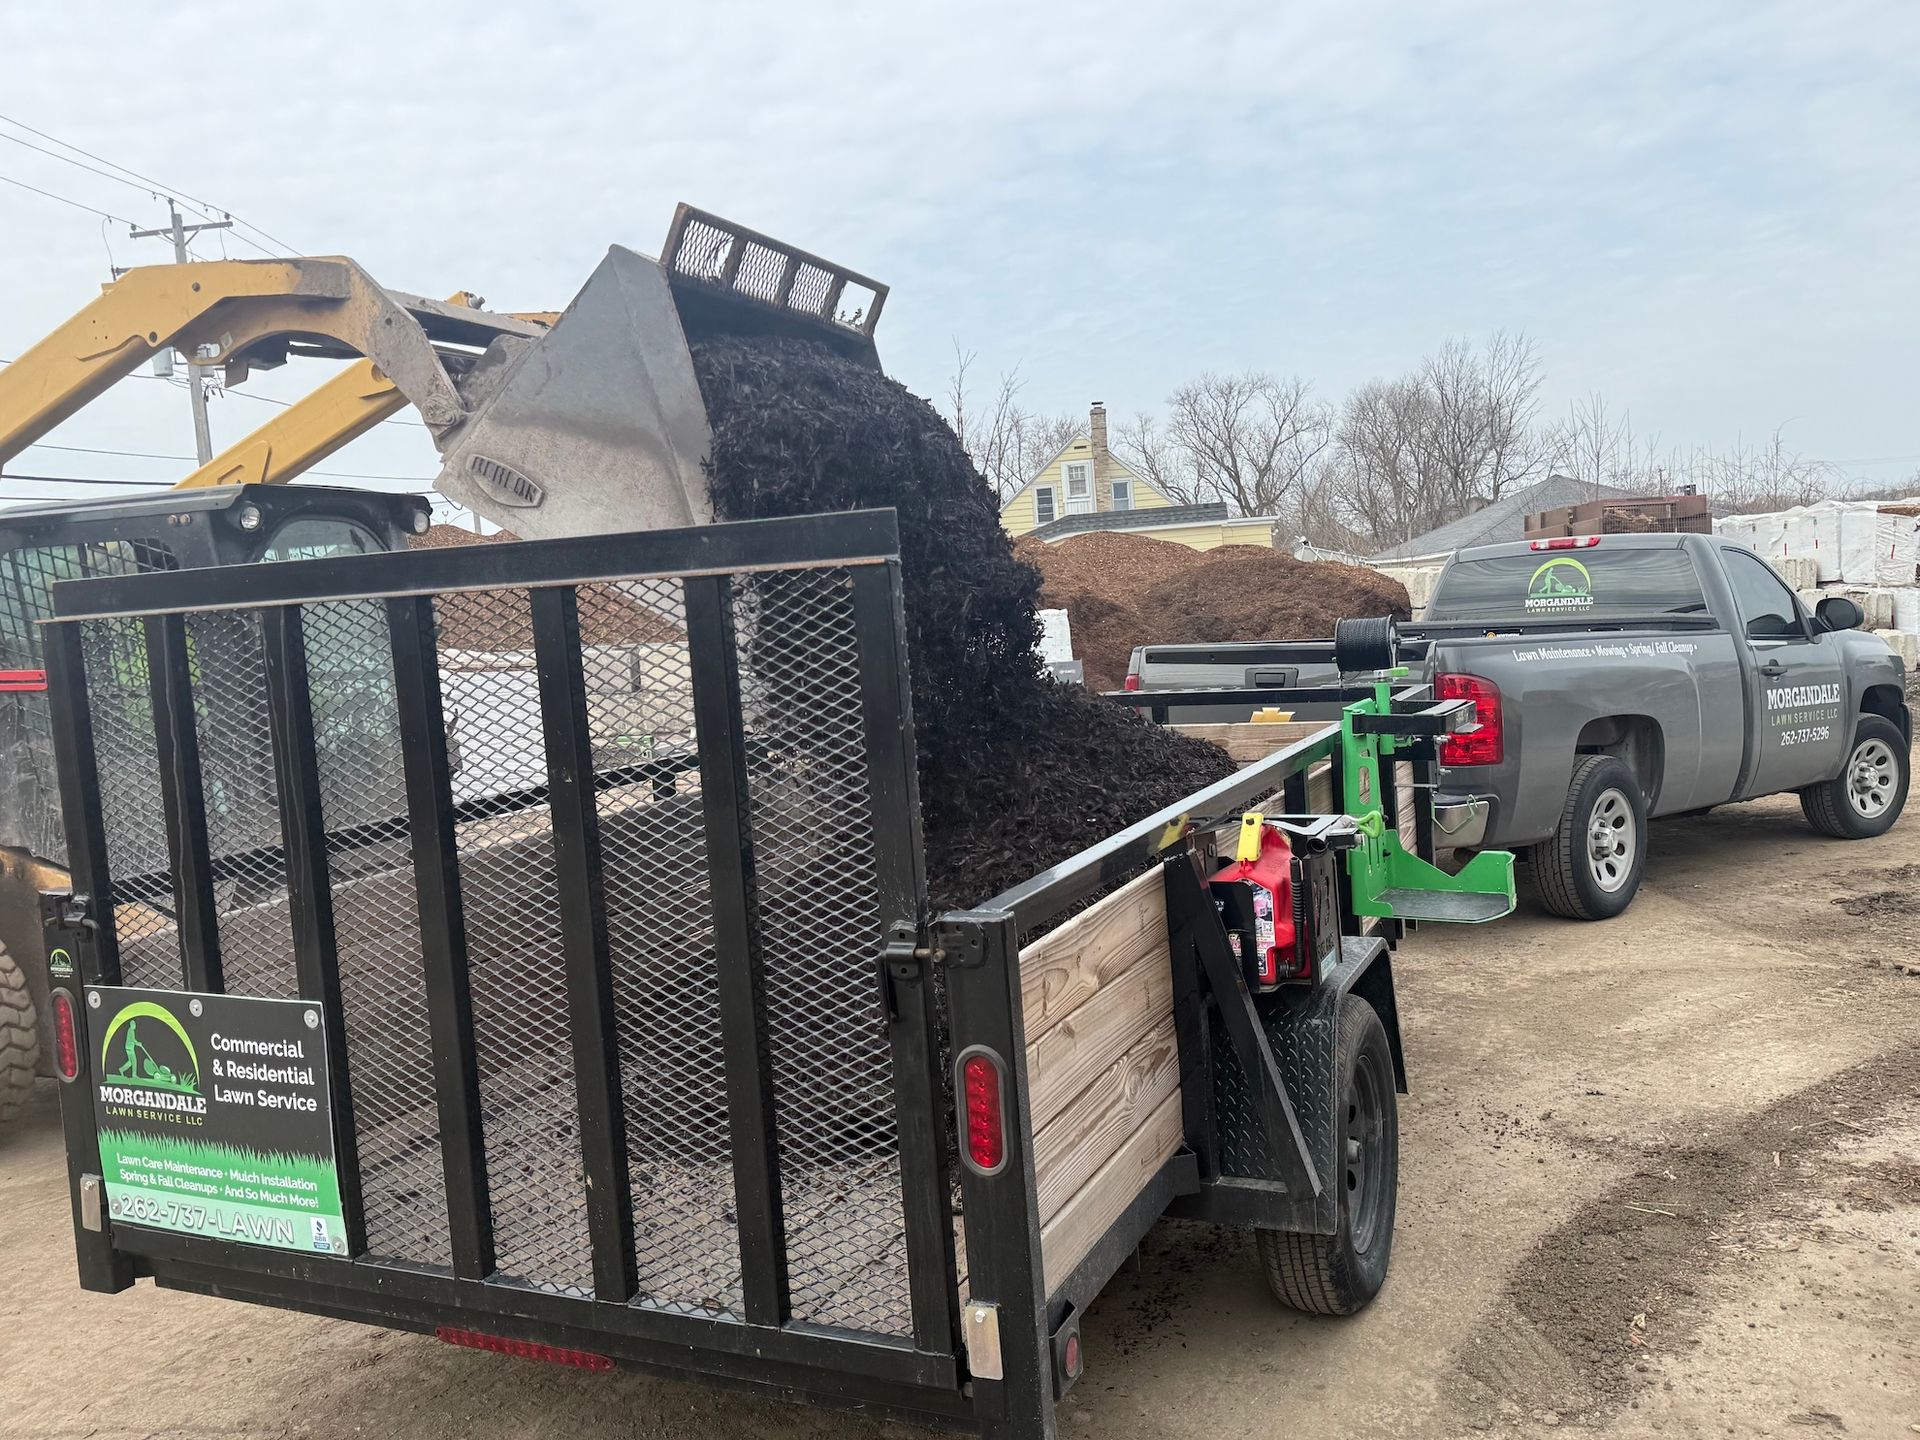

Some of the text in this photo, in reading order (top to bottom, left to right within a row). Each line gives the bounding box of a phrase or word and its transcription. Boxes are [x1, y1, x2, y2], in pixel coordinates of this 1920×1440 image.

[1525, 596, 1594, 608] MORGANDALE
[1512, 649, 1541, 662] Lawn
[1538, 647, 1592, 660] Maintenance
[1594, 644, 1627, 658] Mowing
[1668, 640, 1694, 655] Cleanup
[1766, 683, 1841, 710] MORGANDALE
[1771, 708, 1838, 727] LAWN SERVICE LLC
[1780, 725, 1830, 746] 262-737-5296
[210, 1033, 305, 1059] Commercial
[212, 1058, 315, 1086] & Residential
[99, 1085, 207, 1114] MORGANDALE
[214, 1083, 318, 1112] Lawn Service
[105, 1105, 203, 1126] LAWN SERVICE LLC
[116, 1152, 318, 1192] Lawn Care Maintenance Mulch Installation
[120, 1168, 319, 1209] Spring & Fall Cleanups And So Much More!
[120, 1193, 295, 1244] 262-737-LAWN
